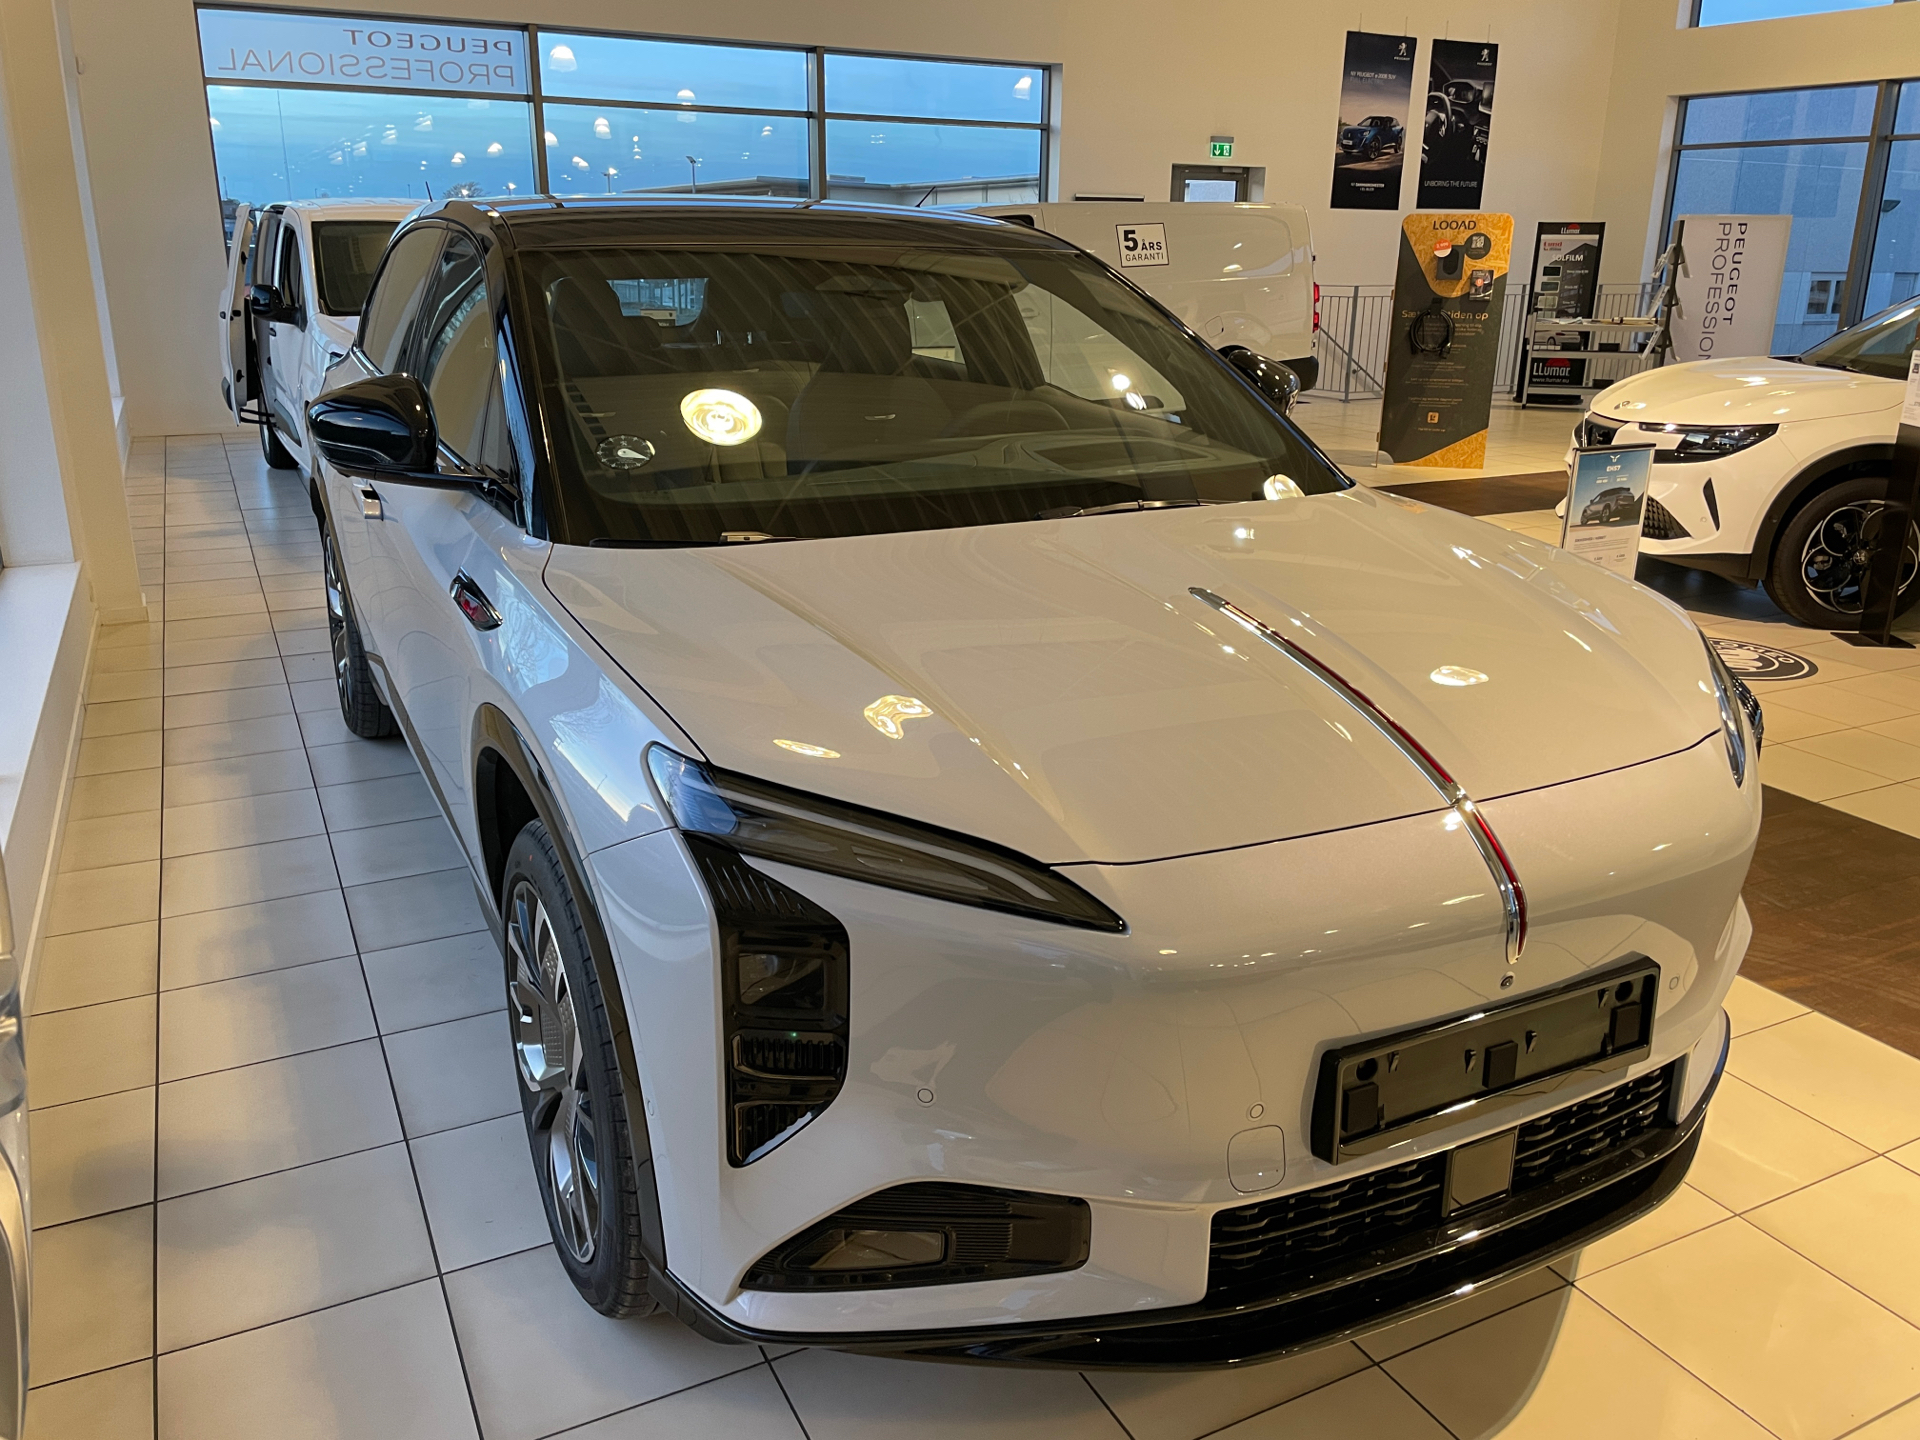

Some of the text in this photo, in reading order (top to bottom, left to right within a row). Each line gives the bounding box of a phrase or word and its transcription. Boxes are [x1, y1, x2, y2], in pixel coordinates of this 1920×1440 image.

[1432, 220, 1477, 230] LOOAD
[1123, 229, 1163, 252] 5 ÅRS
[1125, 252, 1164, 262] GARANTI
[1552, 254, 1584, 262] SOLFILM
[1722, 222, 1748, 325] PEUGEOT
[1475, 312, 1489, 320] op
[1532, 362, 1571, 376] LLumar
